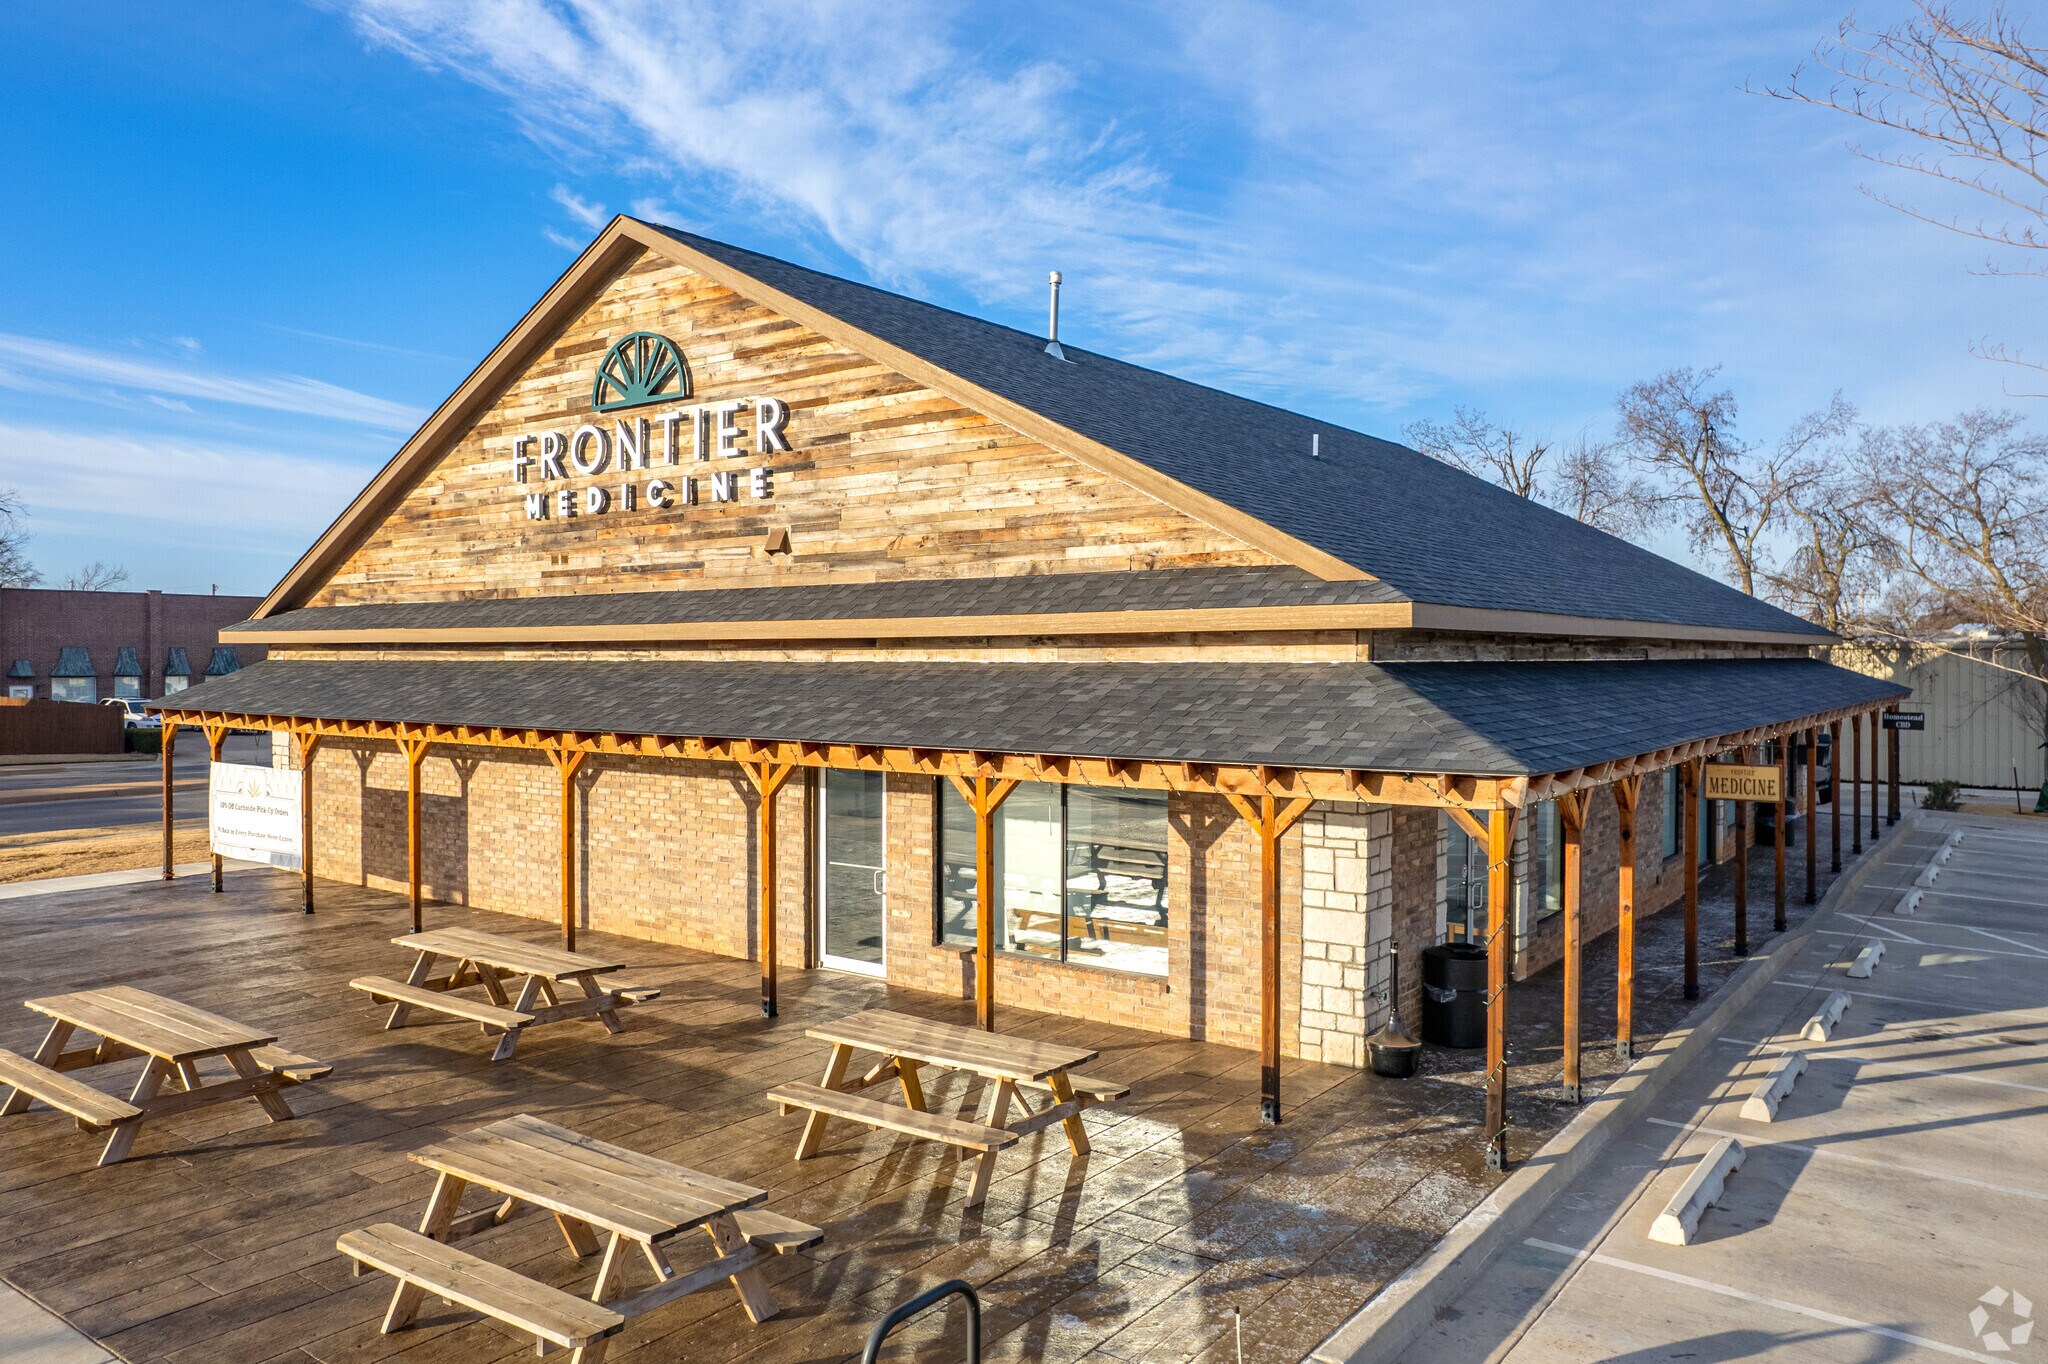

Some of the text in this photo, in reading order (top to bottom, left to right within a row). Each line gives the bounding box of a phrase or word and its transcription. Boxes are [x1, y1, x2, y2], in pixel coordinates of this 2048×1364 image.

[512, 396, 788, 483] FRONTIER
[526, 467, 770, 520] MEDICINE
[1884, 713, 1923, 721] Homestead
[1730, 768, 1756, 777] FRONTIER
[1709, 776, 1777, 797] MEDICINE
[234, 803, 256, 812] Curbside
[274, 807, 289, 816] Orders
